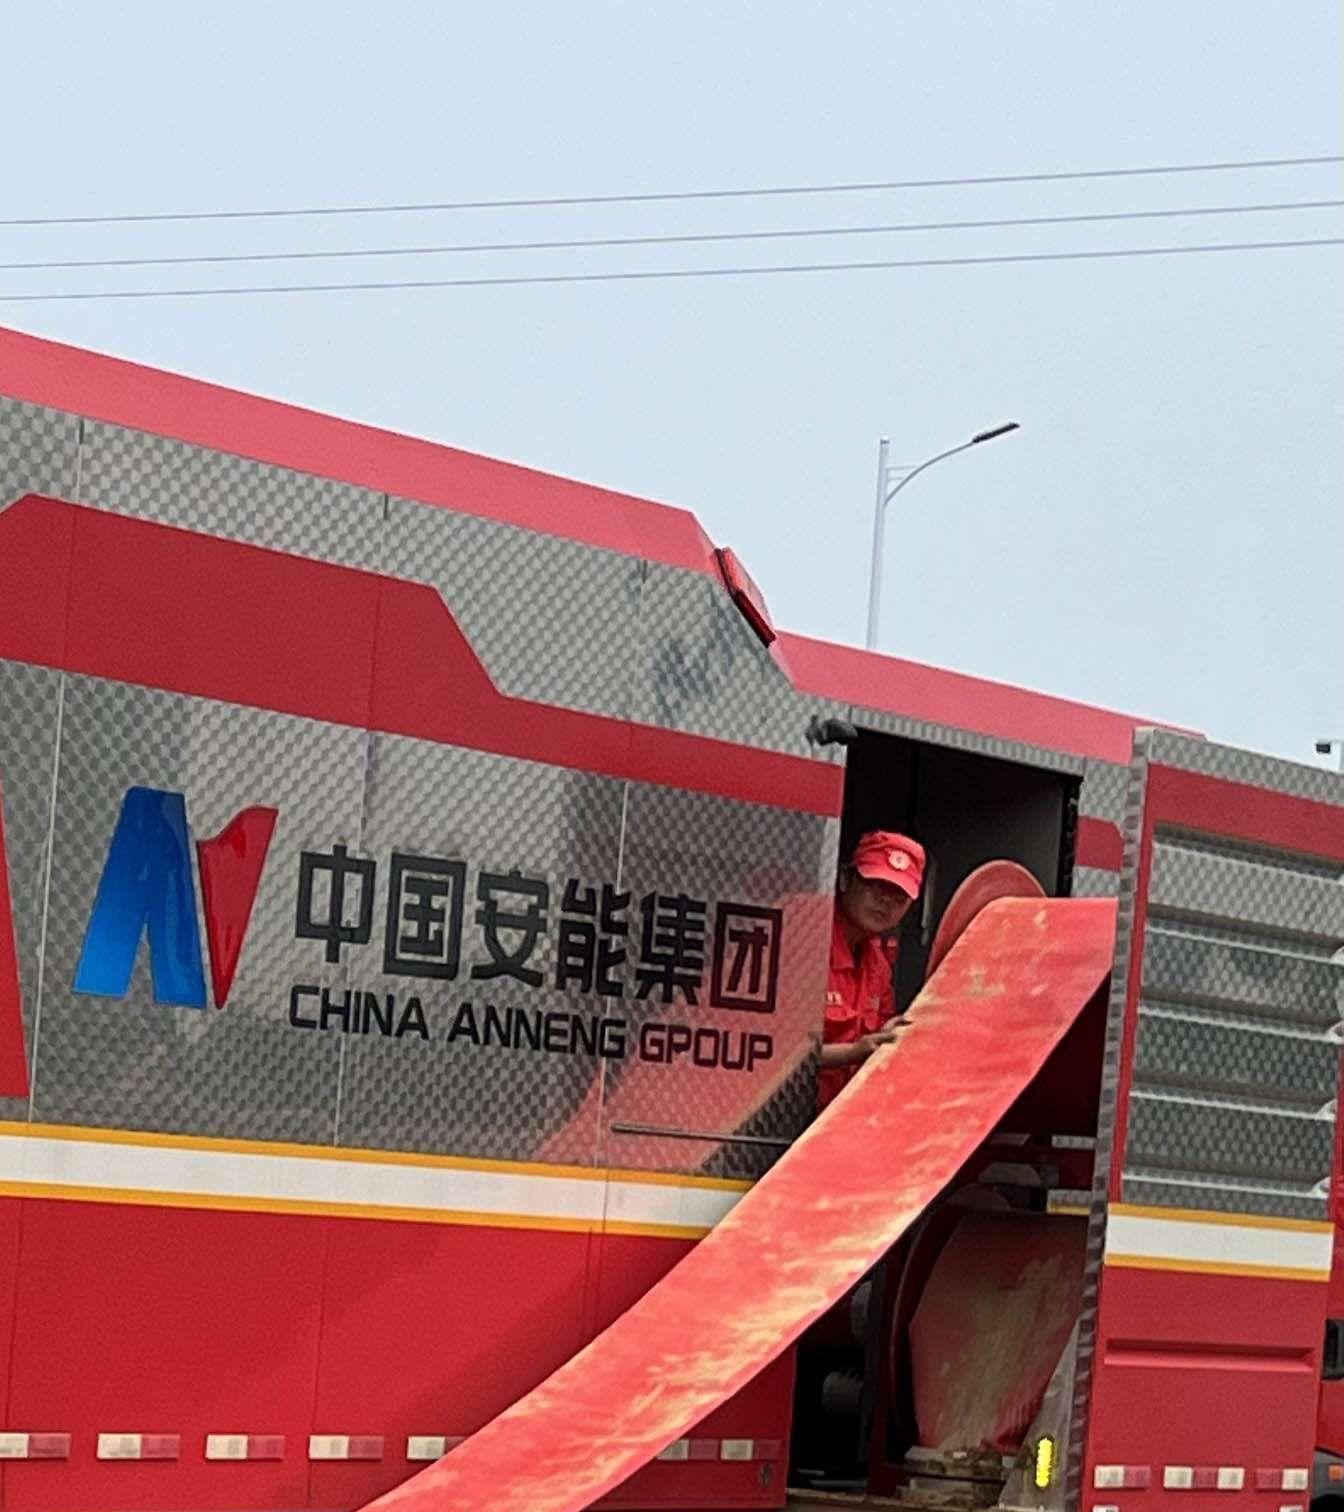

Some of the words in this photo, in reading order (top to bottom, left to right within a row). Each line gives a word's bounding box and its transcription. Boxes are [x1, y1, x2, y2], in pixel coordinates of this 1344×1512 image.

[295, 844, 783, 1014] 中国安能集团
[289, 984, 430, 1041] CHINA
[446, 1002, 627, 1060] ANNENG
